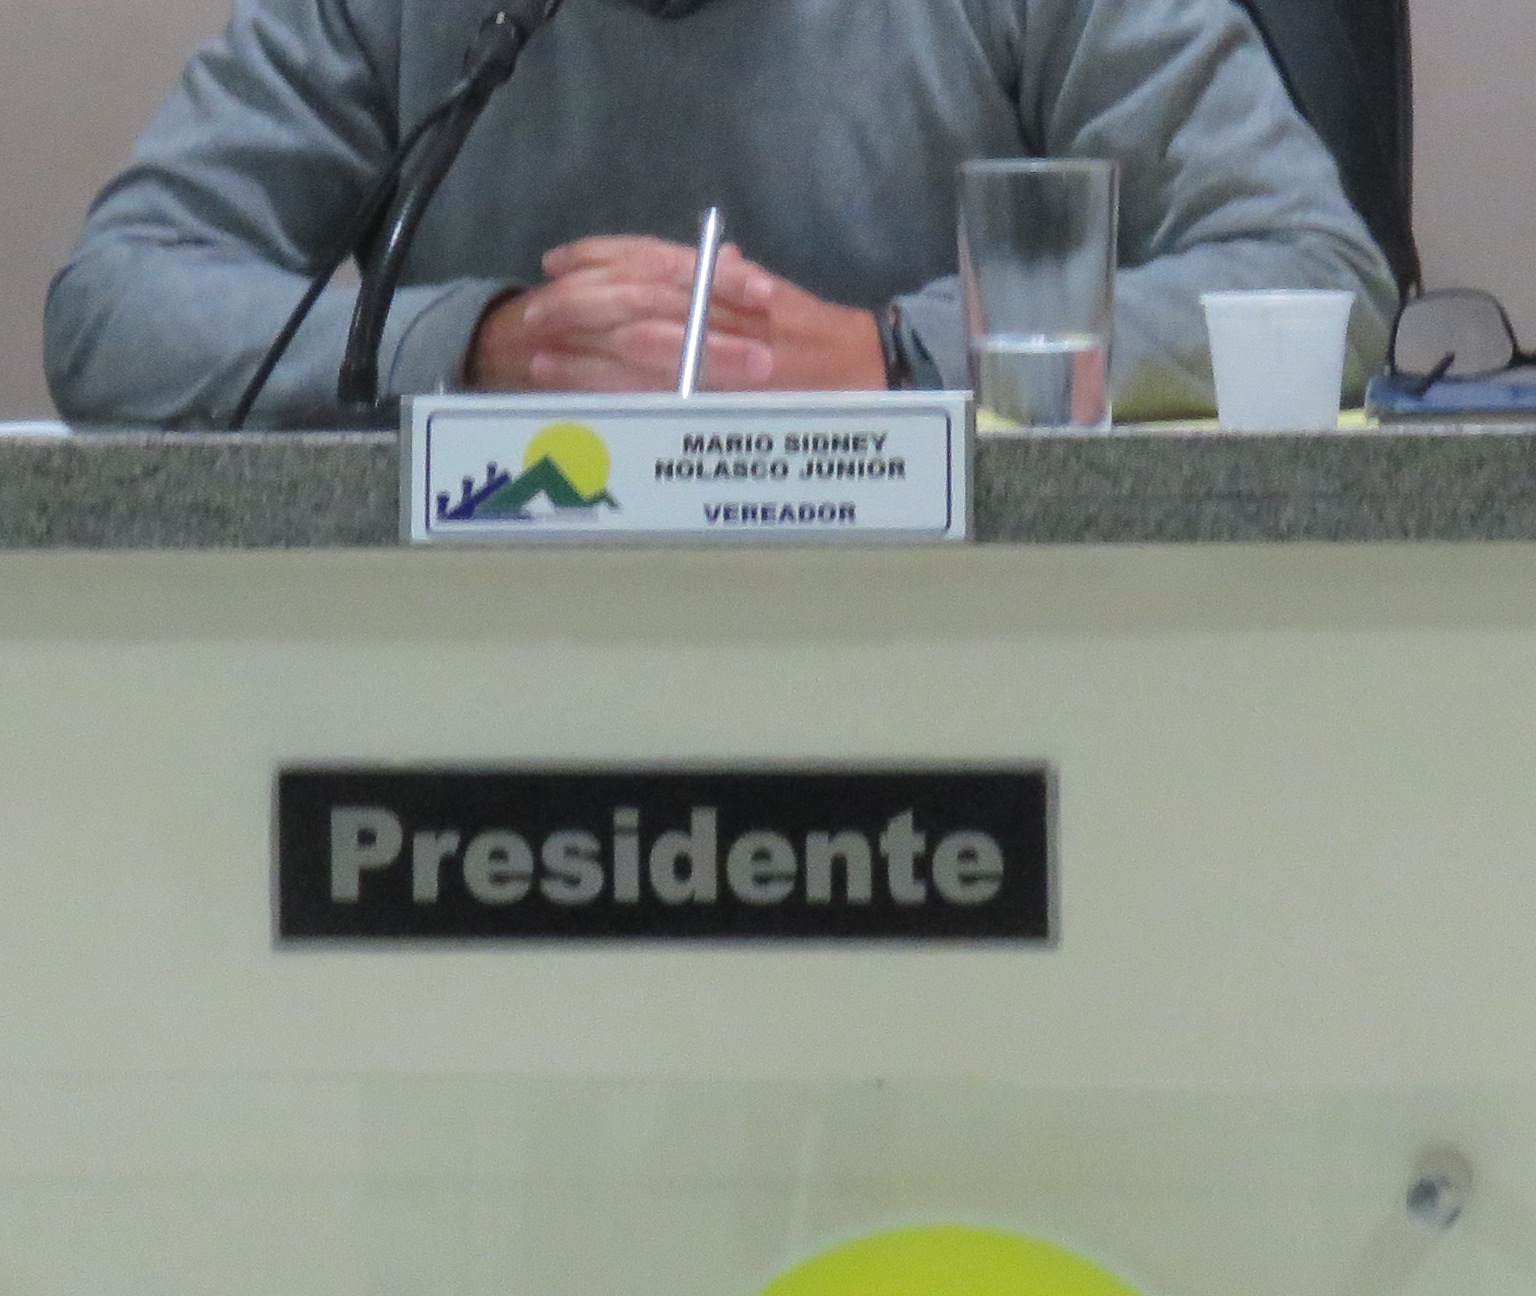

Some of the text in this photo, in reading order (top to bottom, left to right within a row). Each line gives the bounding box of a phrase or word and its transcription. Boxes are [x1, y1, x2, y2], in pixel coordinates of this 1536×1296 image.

[682, 431, 888, 454] MARIO SIDNEY
[654, 458, 789, 481] NOLASCO
[703, 503, 857, 525] VEREADOR
[330, 805, 1005, 904] Presidente
